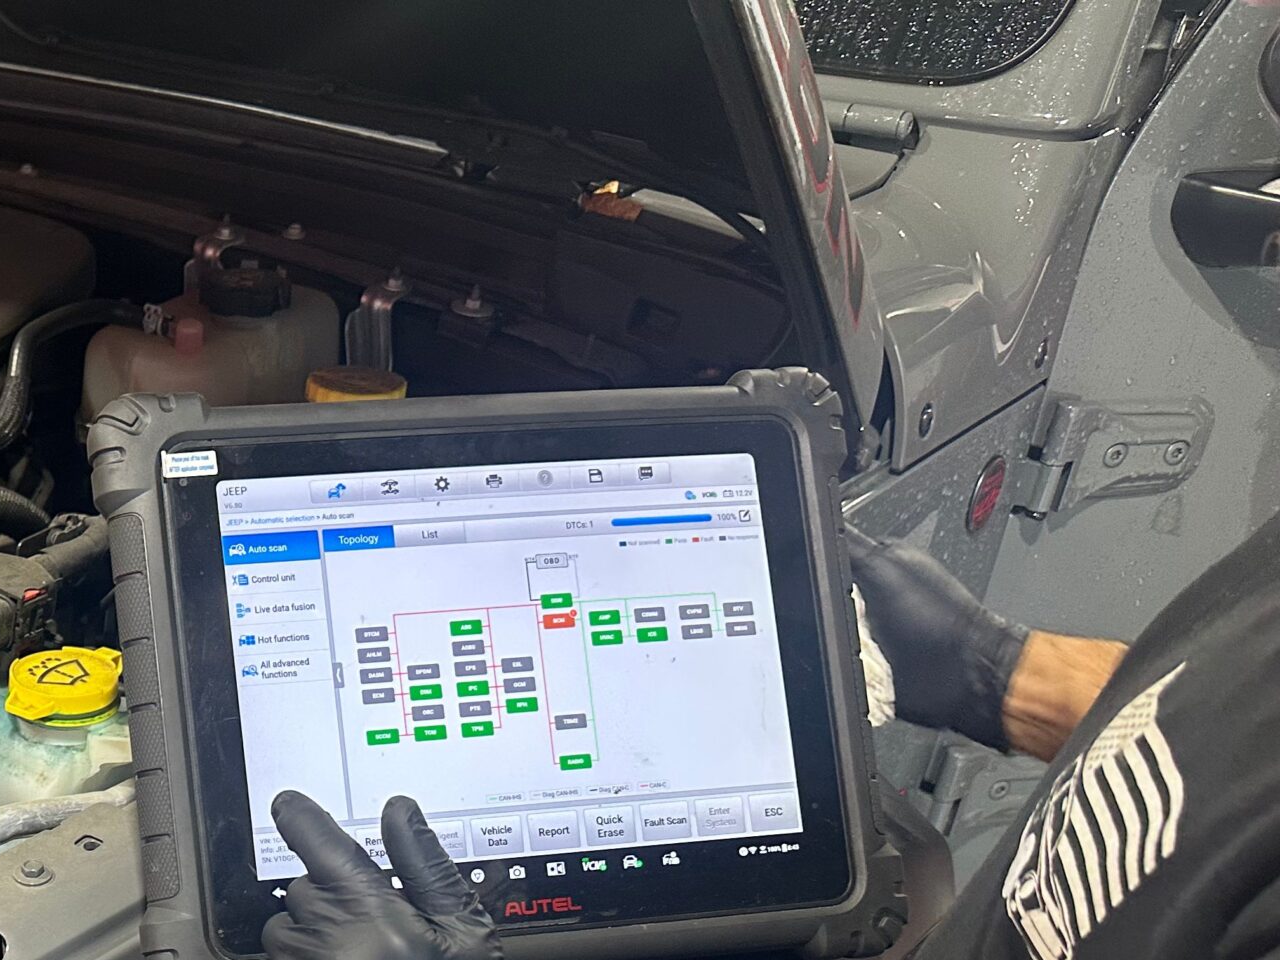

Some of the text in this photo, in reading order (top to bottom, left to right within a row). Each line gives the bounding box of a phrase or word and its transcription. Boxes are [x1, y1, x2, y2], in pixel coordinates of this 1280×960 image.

[223, 487, 247, 496] JEEP
[250, 515, 284, 525] Automatic
[286, 514, 315, 523] selection
[717, 513, 736, 521] 100%
[338, 534, 379, 546] Topology
[422, 531, 438, 539] List
[249, 544, 287, 553] Auto scan
[544, 557, 559, 565] OBD
[252, 573, 295, 583] Control unit
[255, 603, 315, 614] Live data fusion
[258, 633, 309, 644] Hot functions
[260, 658, 309, 669] All advanced
[262, 669, 297, 679] functions
[709, 807, 731, 816] Enter
[765, 807, 783, 817] ESC
[596, 815, 623, 825] Quick
[644, 817, 687, 827] Fault Scan
[705, 818, 736, 829] System
[481, 825, 512, 836] Vehicle
[538, 826, 570, 837] Report
[598, 829, 624, 838] Erase
[365, 837, 383, 845] Rem
[488, 839, 508, 847] Data
[369, 849, 389, 858] Exp
[505, 897, 582, 917] AUTEL
